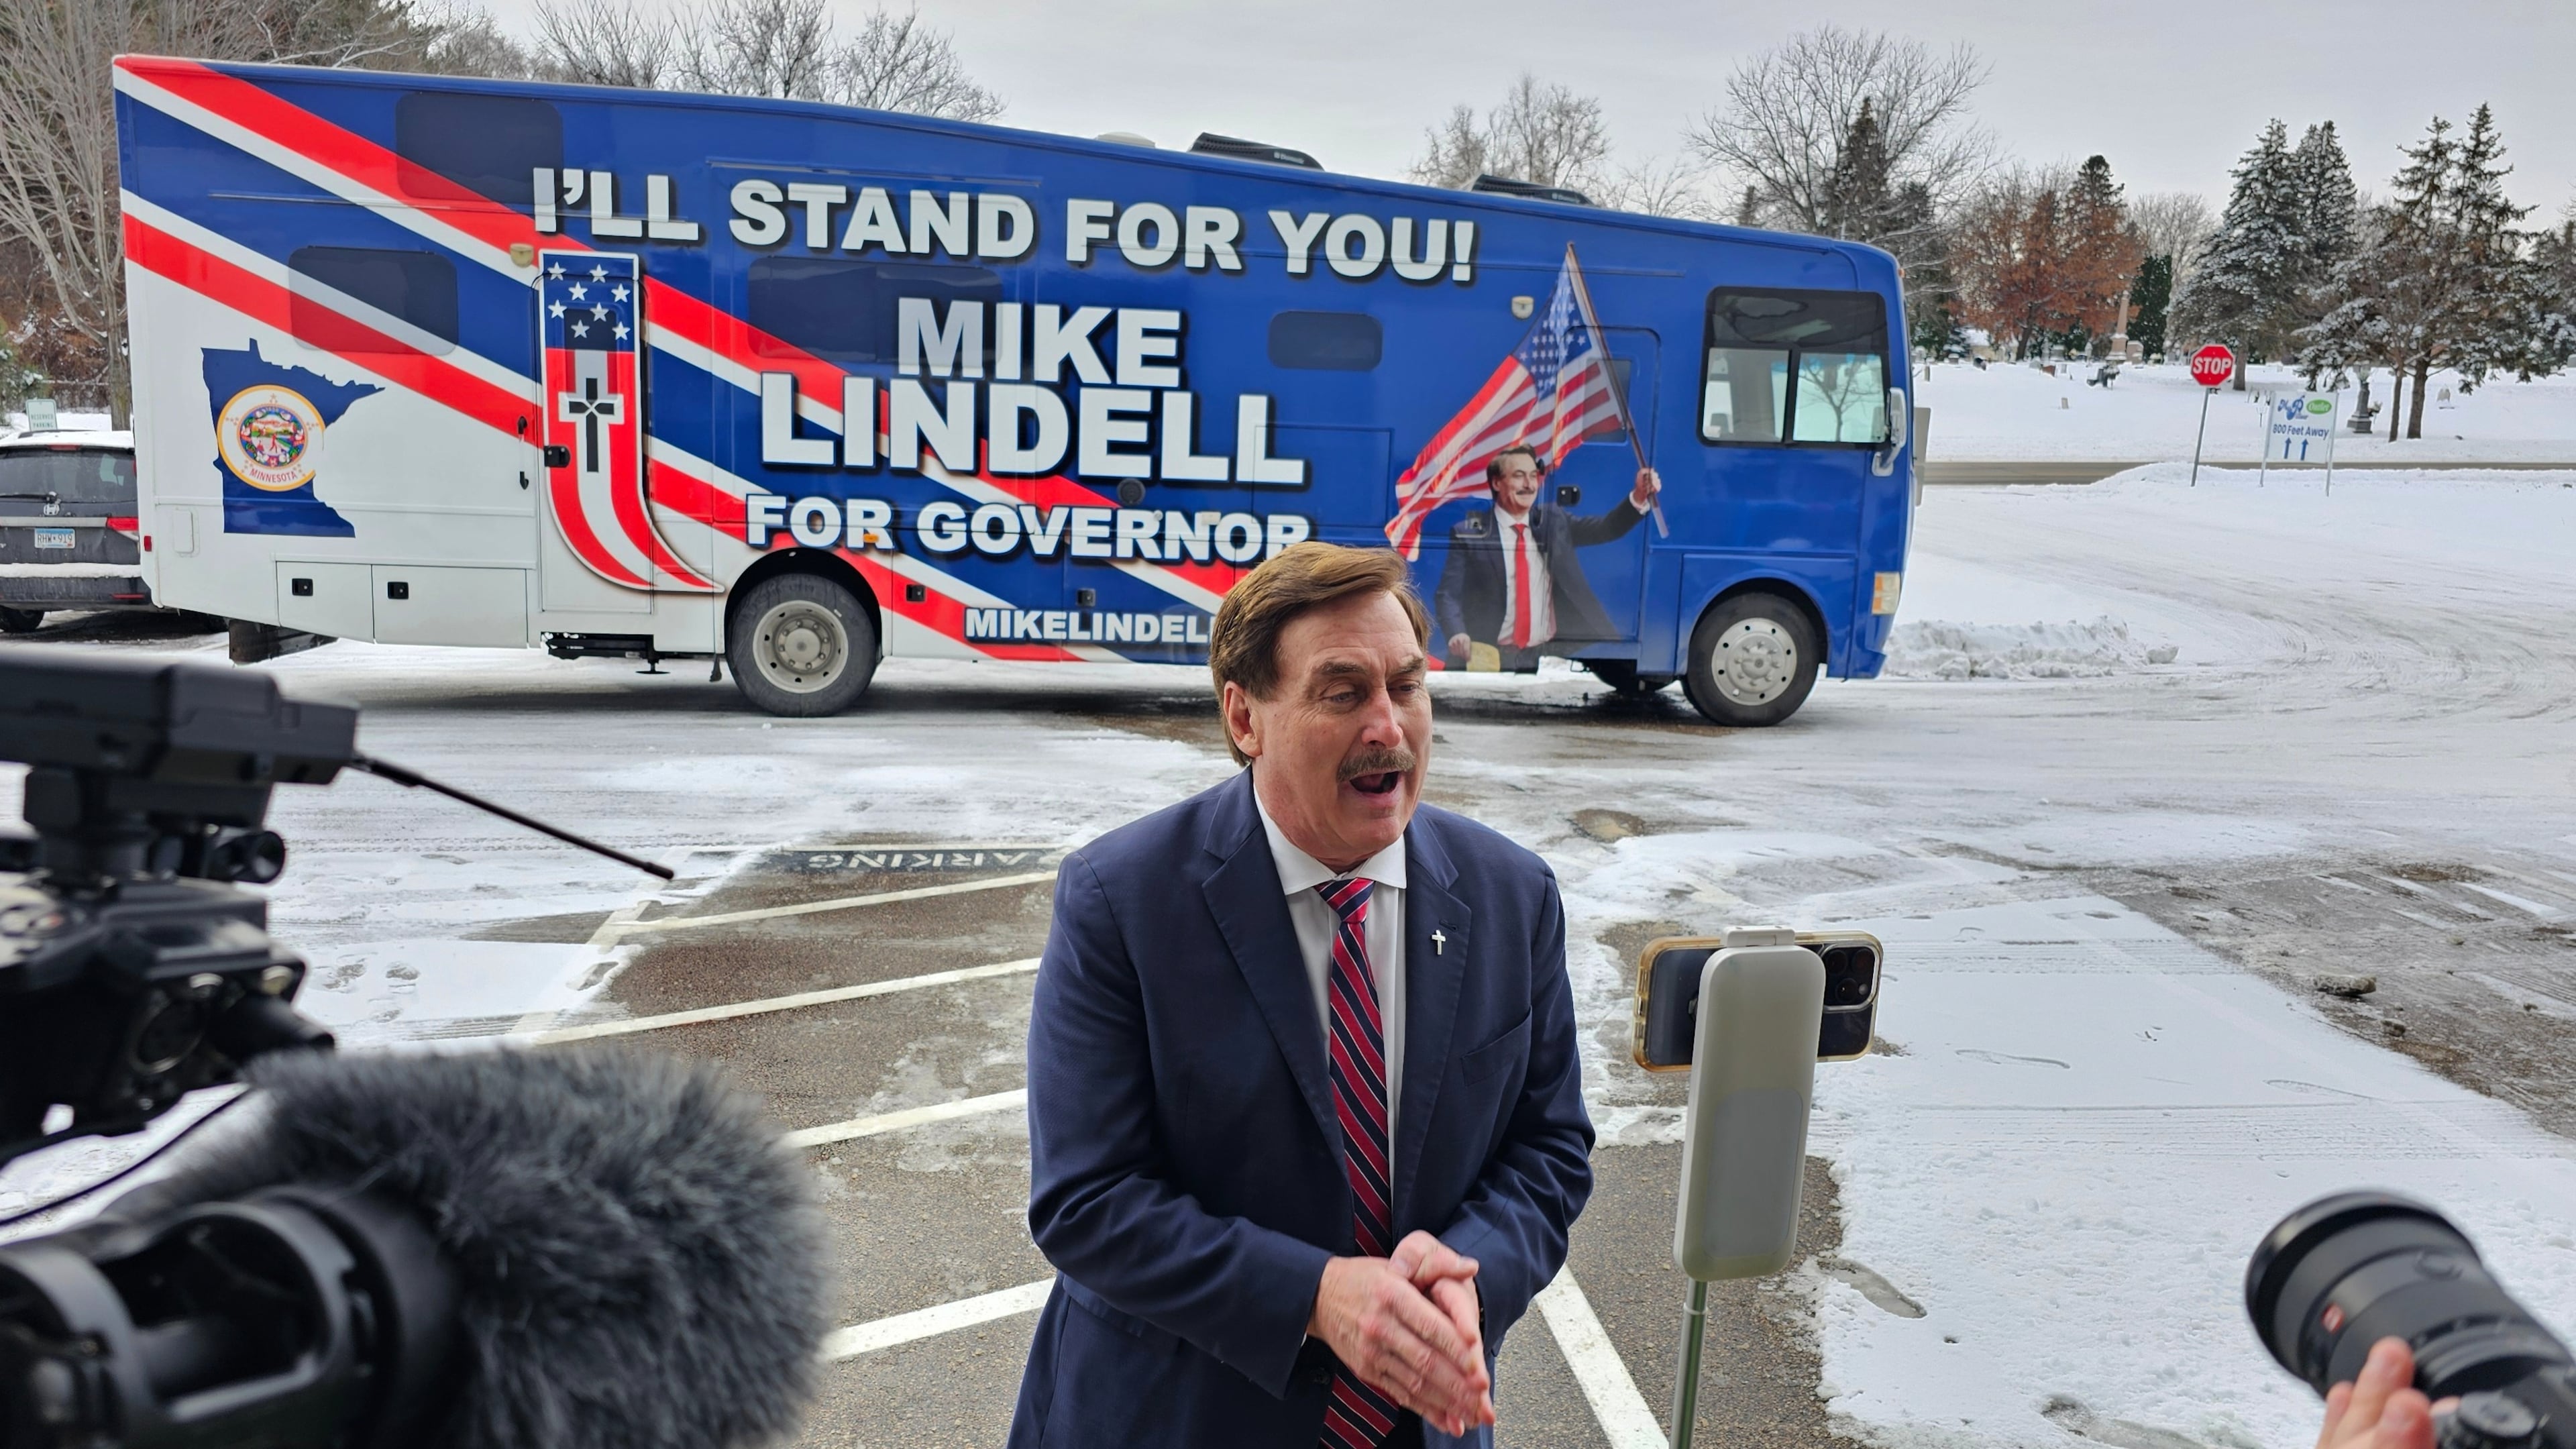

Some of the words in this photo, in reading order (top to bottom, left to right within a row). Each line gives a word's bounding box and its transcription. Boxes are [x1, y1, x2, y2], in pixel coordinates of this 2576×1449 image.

[533, 167, 698, 240] I'LL
[729, 179, 1034, 258] STAND
[1066, 198, 1242, 270] FOR
[1268, 210, 1473, 282] YOU!
[898, 297, 1181, 387] MIKE
[2192, 357, 2232, 375] STOP
[761, 372, 1305, 484] LINDELL
[2272, 423, 2287, 434] 800
[2287, 425, 2304, 436] Feet
[2304, 426, 2329, 441] Away
[249, 468, 297, 483] MINNESOTA
[747, 494, 894, 549] FOR
[917, 502, 1309, 562] GOVERNOR
[965, 608, 1216, 643] MIKELINDEL
